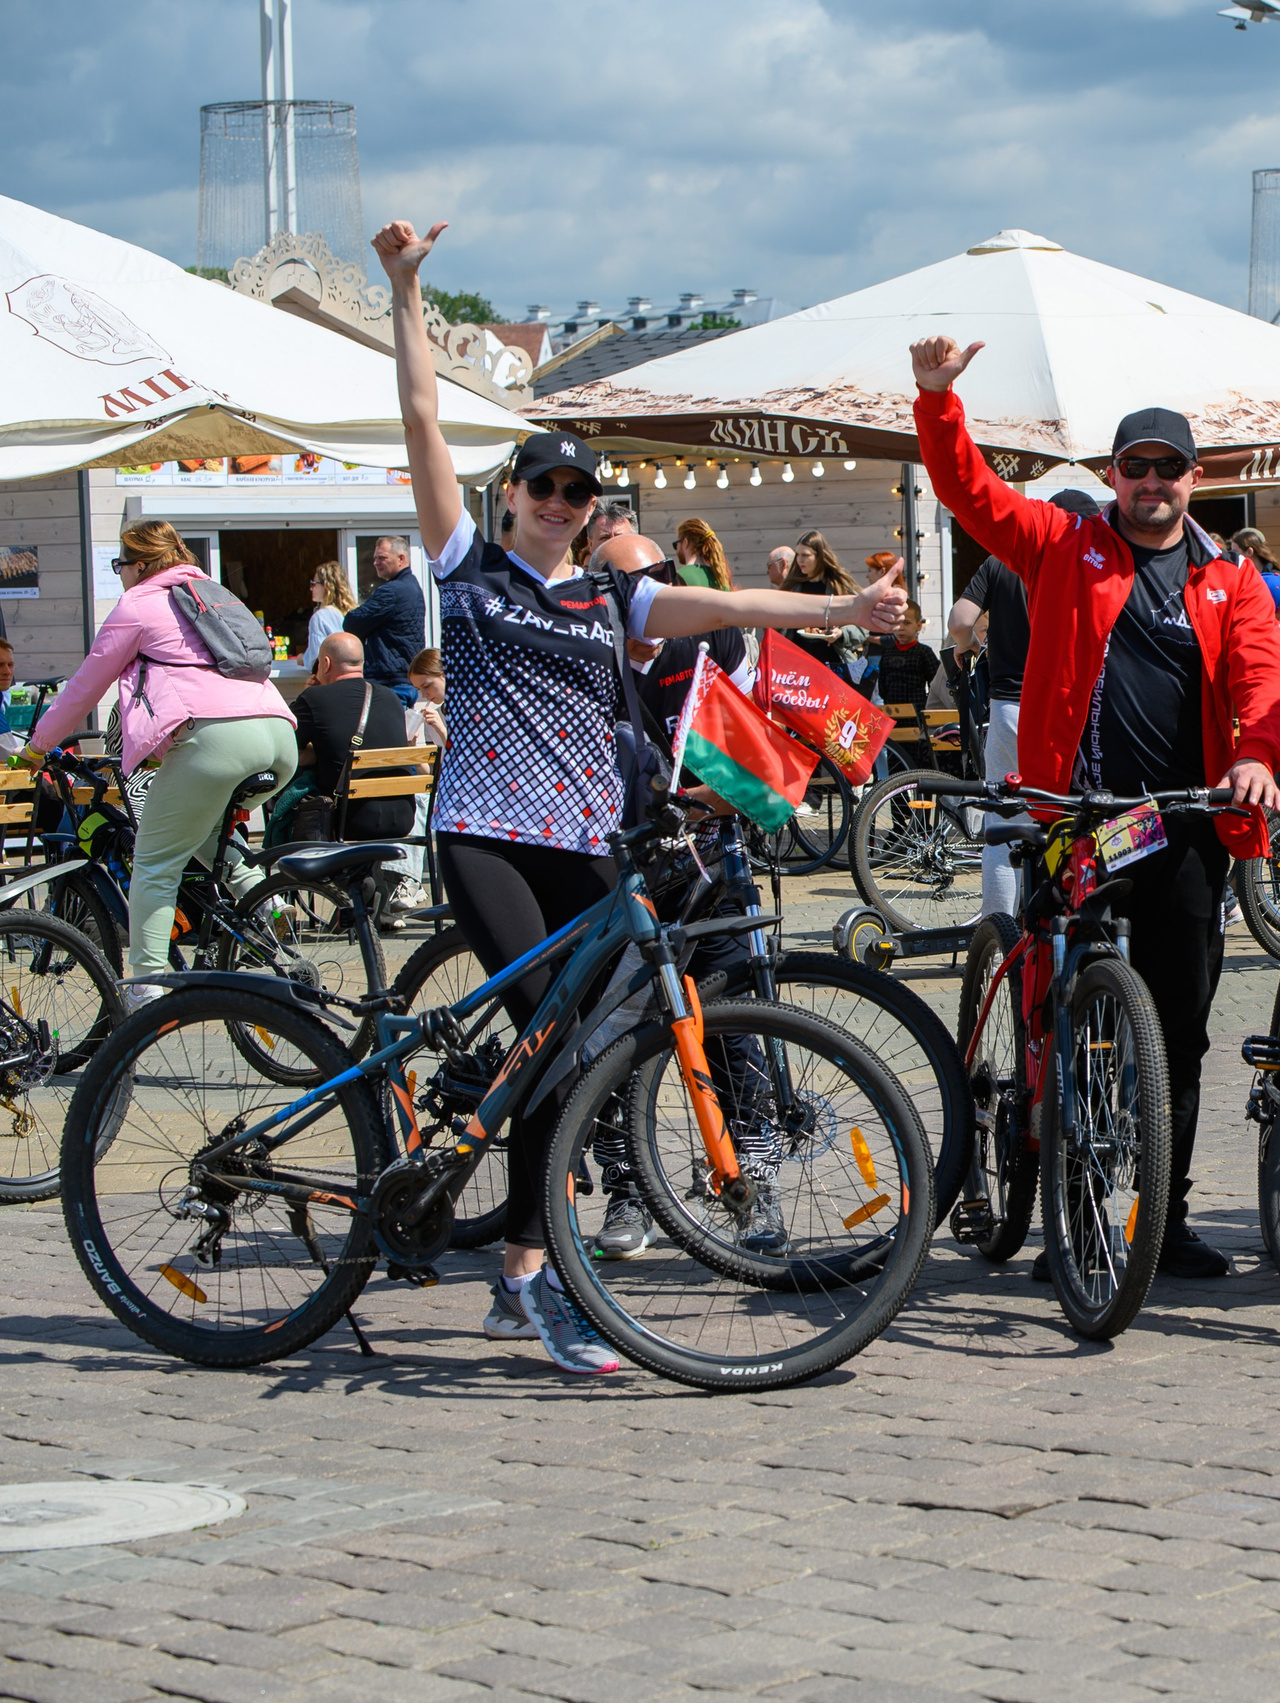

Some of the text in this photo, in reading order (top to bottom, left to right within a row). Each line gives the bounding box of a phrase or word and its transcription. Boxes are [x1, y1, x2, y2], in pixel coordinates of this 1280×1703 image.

[772, 687, 830, 710] обеды!
[838, 720, 858, 749] 9
[1107, 846, 1133, 862] 11903
[250, 1181, 285, 1192] ROCKY
[308, 1190, 332, 1203] 29
[83, 1239, 122, 1295] BARZO
[720, 1362, 784, 1376] KENDA
